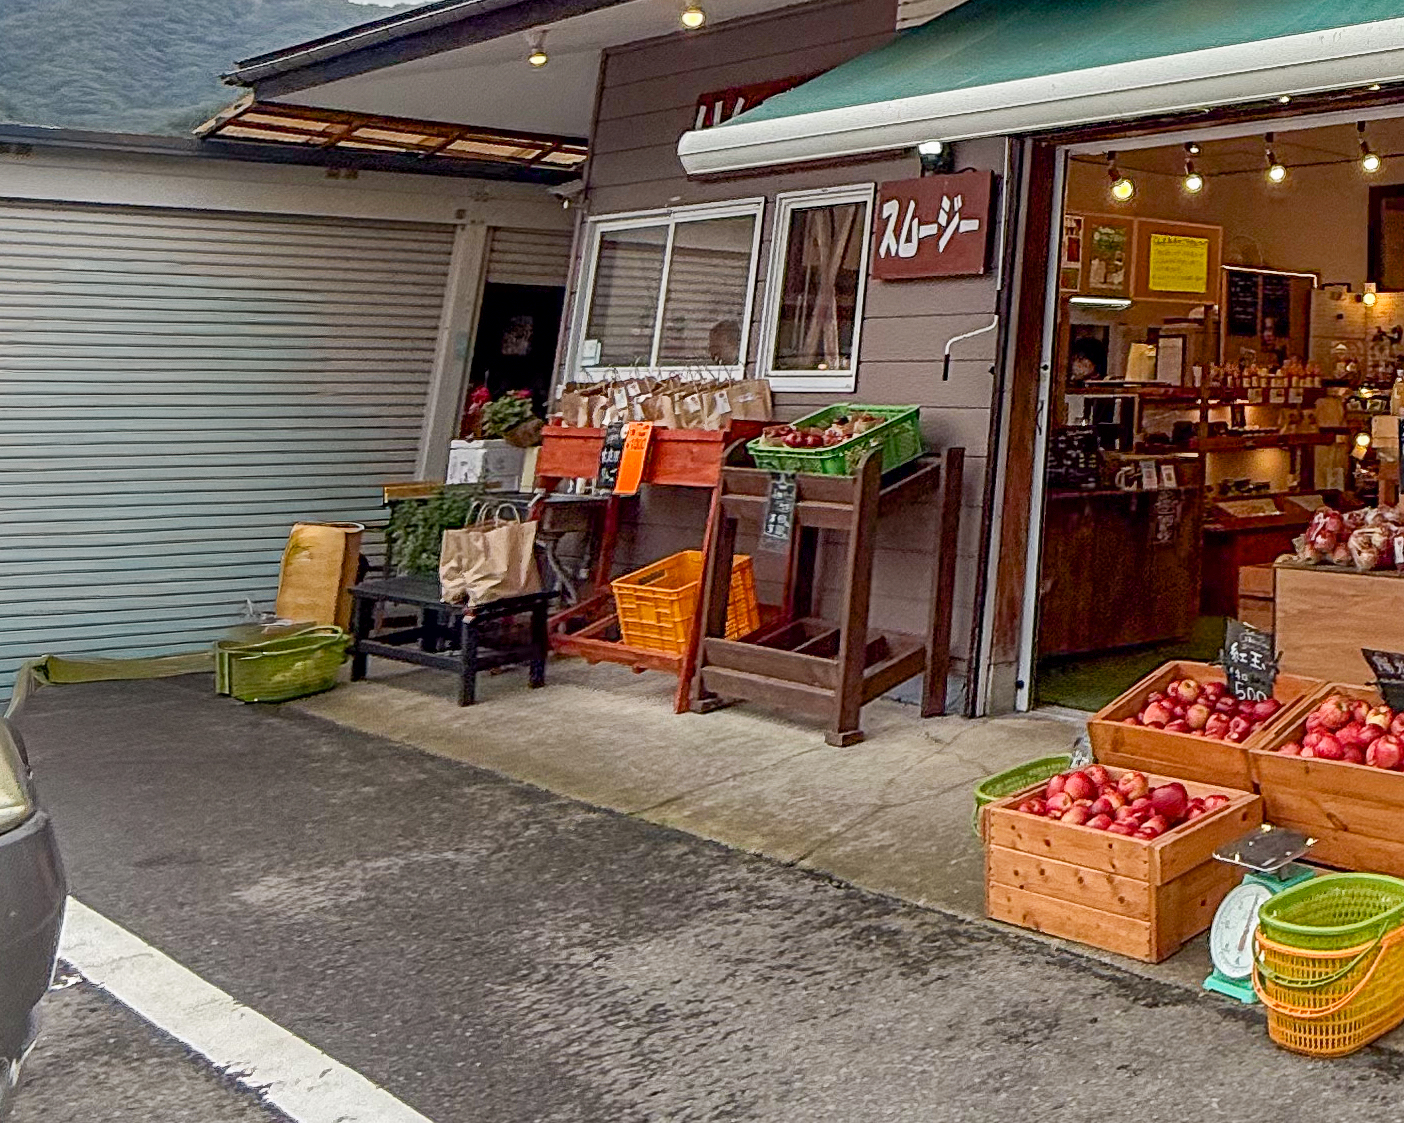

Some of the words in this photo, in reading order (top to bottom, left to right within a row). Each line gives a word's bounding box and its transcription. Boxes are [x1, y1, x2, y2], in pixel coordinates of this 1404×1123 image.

[879, 193, 980, 259] スムージー
